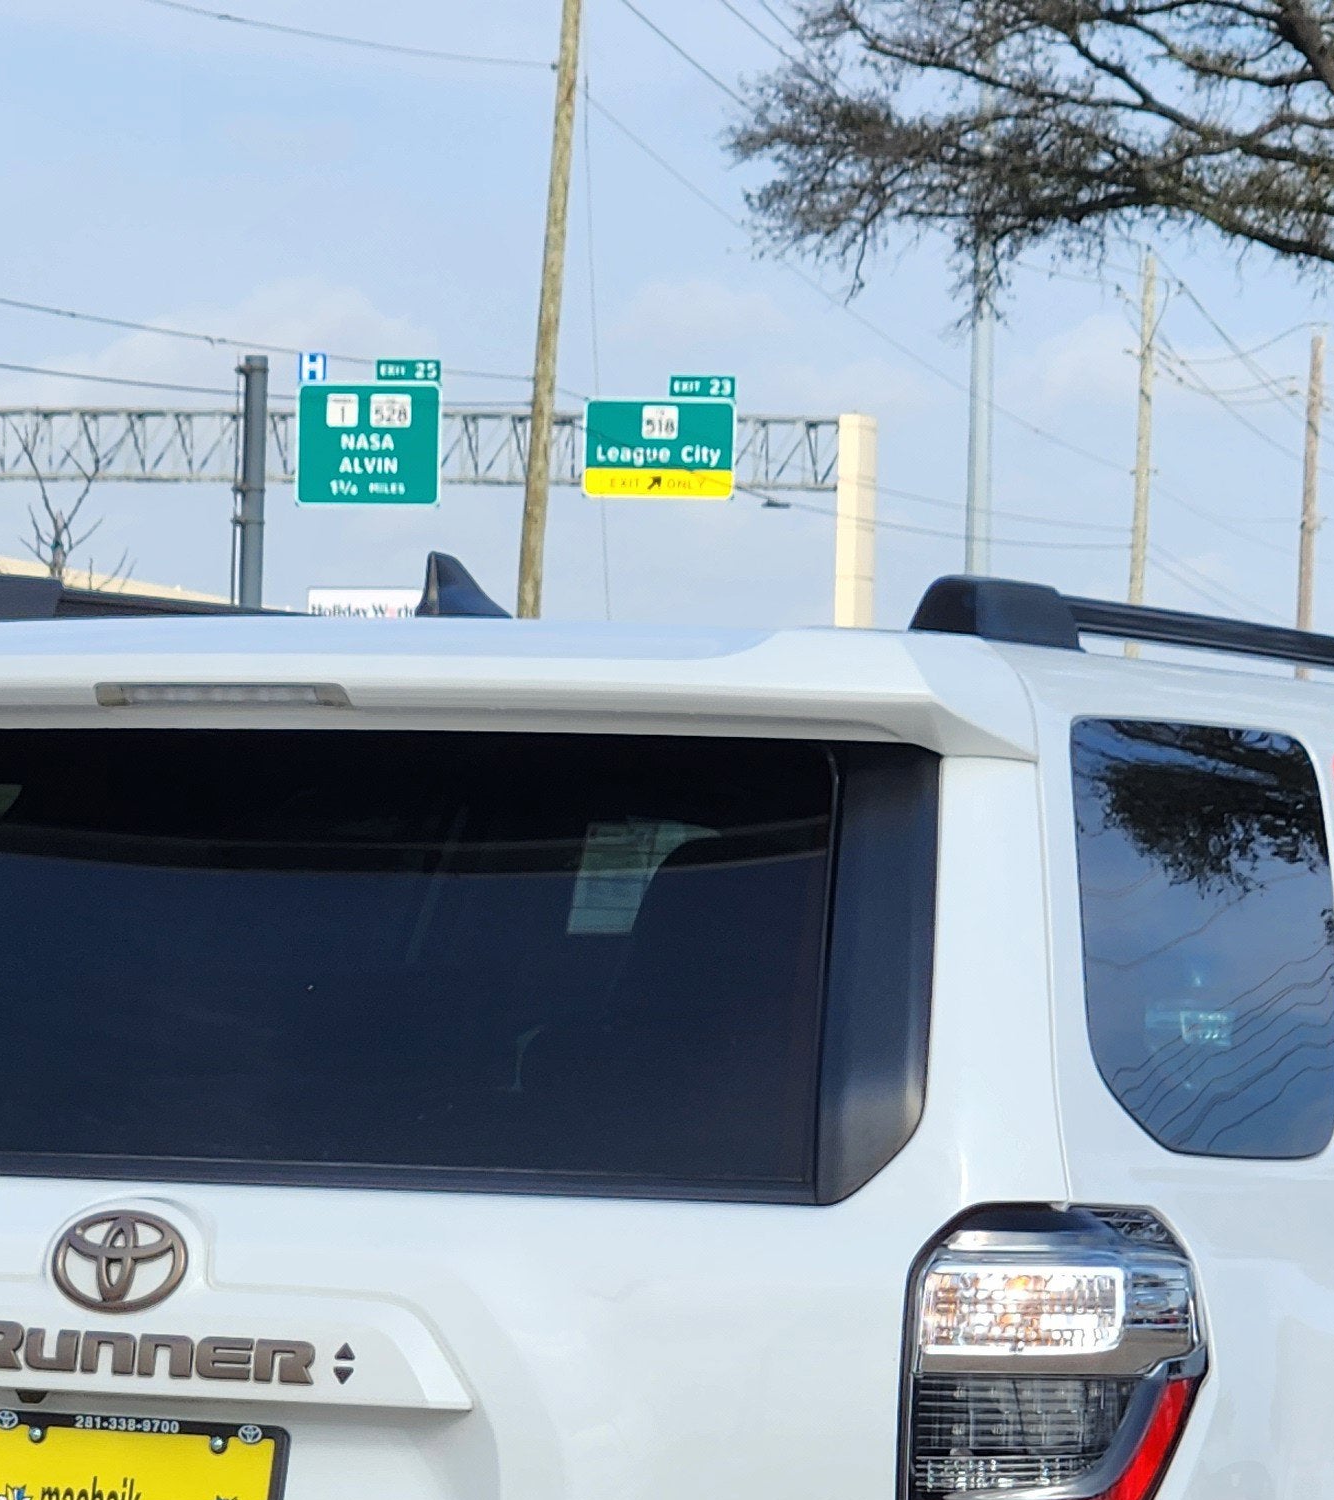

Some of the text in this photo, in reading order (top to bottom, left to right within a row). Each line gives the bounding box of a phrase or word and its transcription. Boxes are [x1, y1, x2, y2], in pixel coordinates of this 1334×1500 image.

[379, 362, 438, 378] EXIT 25
[673, 378, 732, 396] EXIT 23
[374, 405, 408, 424] 528
[645, 417, 675, 435] 518
[340, 432, 395, 451] NASA
[596, 444, 722, 467] League City
[339, 456, 398, 474] ALVIN
[368, 482, 406, 495] MILES
[609, 478, 706, 489] EXIT ONLY
